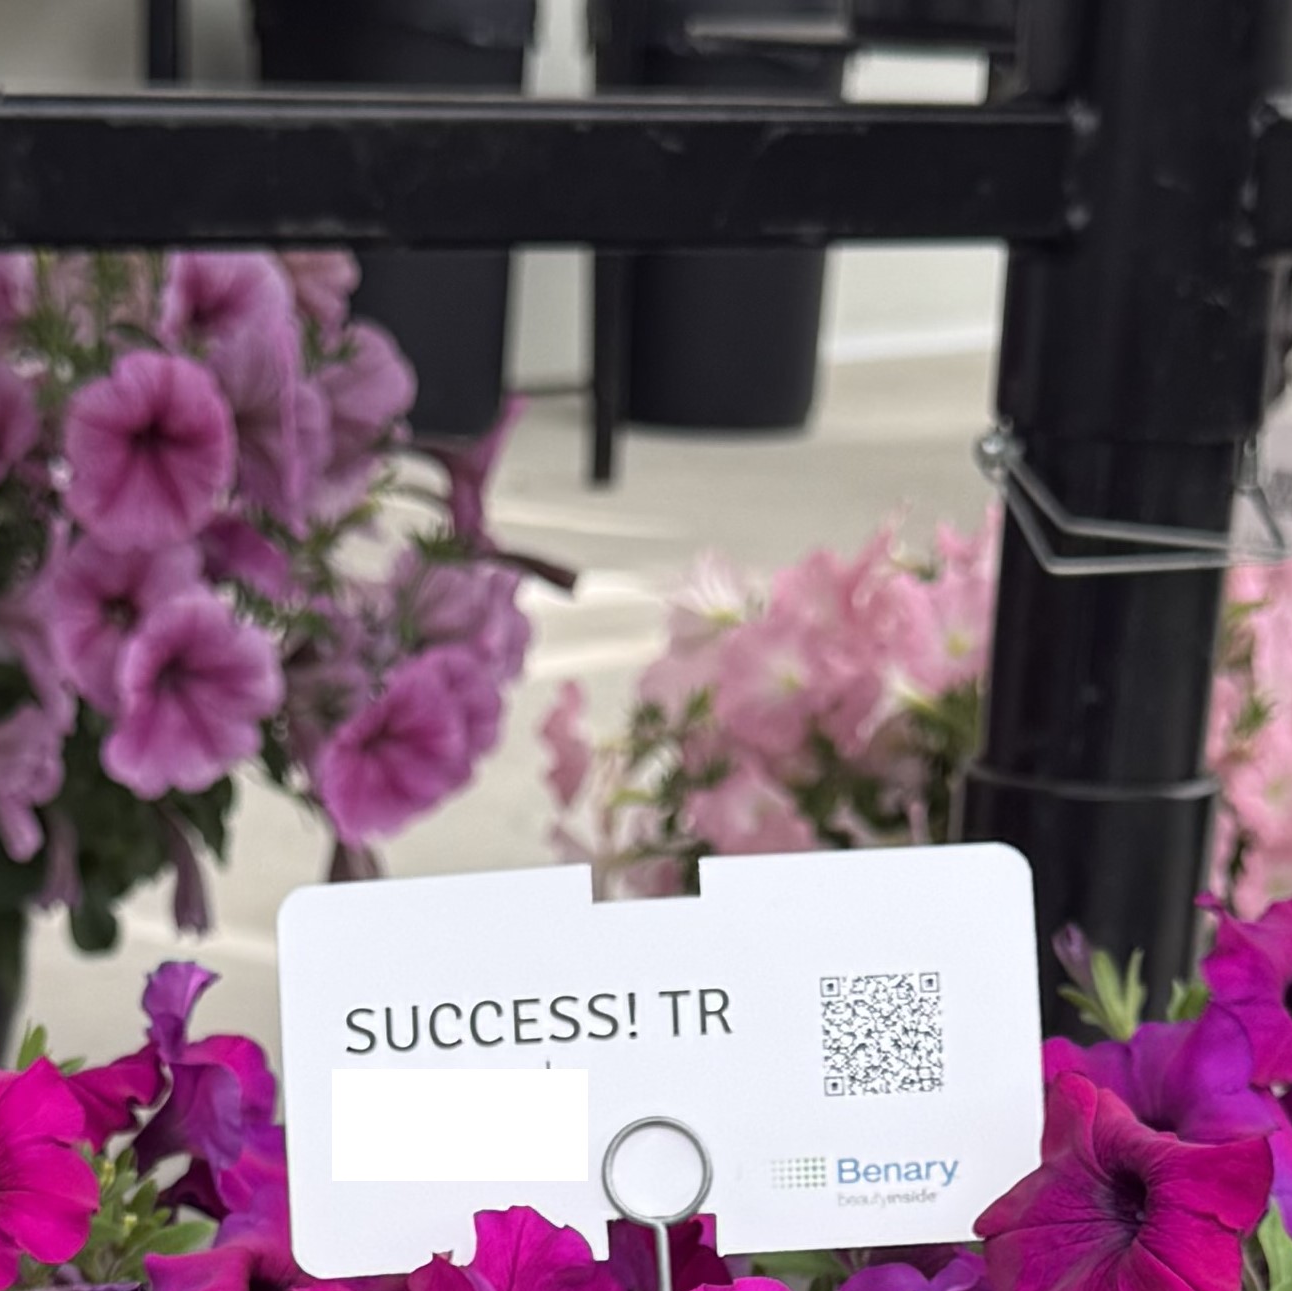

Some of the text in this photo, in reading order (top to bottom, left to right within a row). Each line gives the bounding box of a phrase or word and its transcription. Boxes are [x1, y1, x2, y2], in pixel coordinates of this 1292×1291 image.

[345, 988, 732, 1054] SUCCESS! TR
[837, 1158, 959, 1187] Benary
